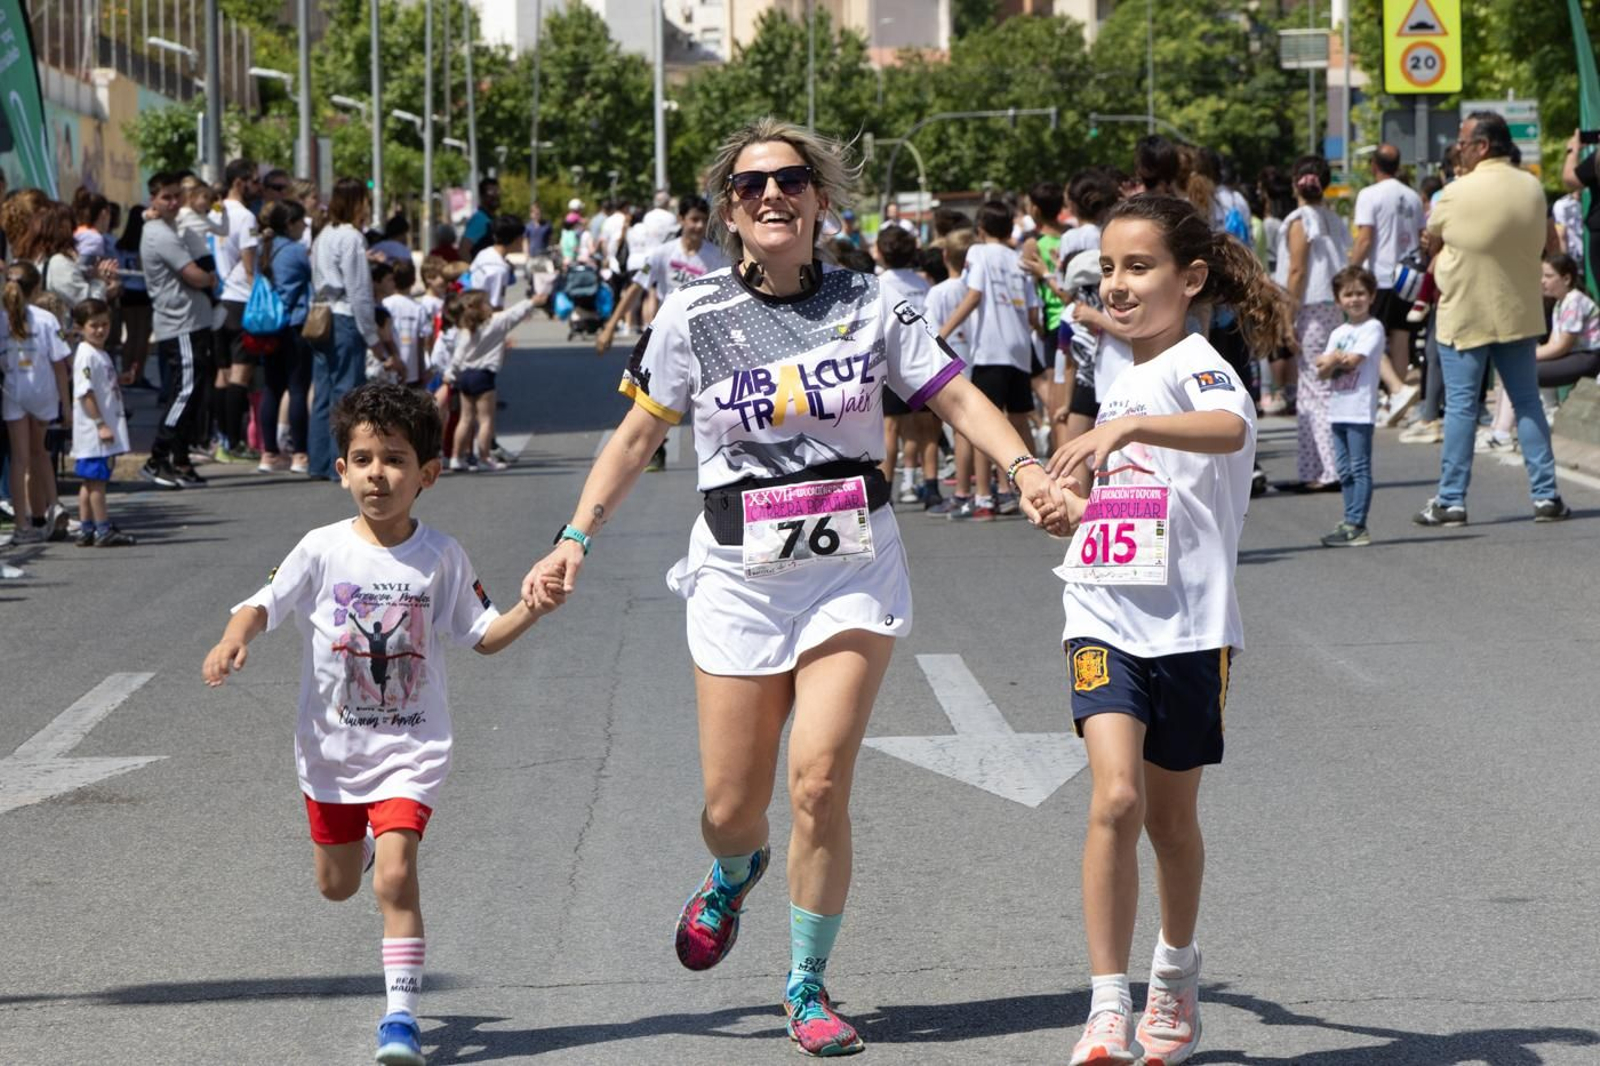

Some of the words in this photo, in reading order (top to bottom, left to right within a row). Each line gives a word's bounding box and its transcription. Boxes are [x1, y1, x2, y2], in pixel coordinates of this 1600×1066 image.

[1410, 55, 1437, 70] 20
[715, 352, 874, 416] JABALCUZ
[730, 372, 836, 432] TRAIL
[833, 387, 873, 428] Jaén
[1106, 502, 1161, 518] POPULAR
[777, 515, 841, 559] 76
[1081, 523, 1137, 565] 615
[372, 583, 411, 592] XXVII
